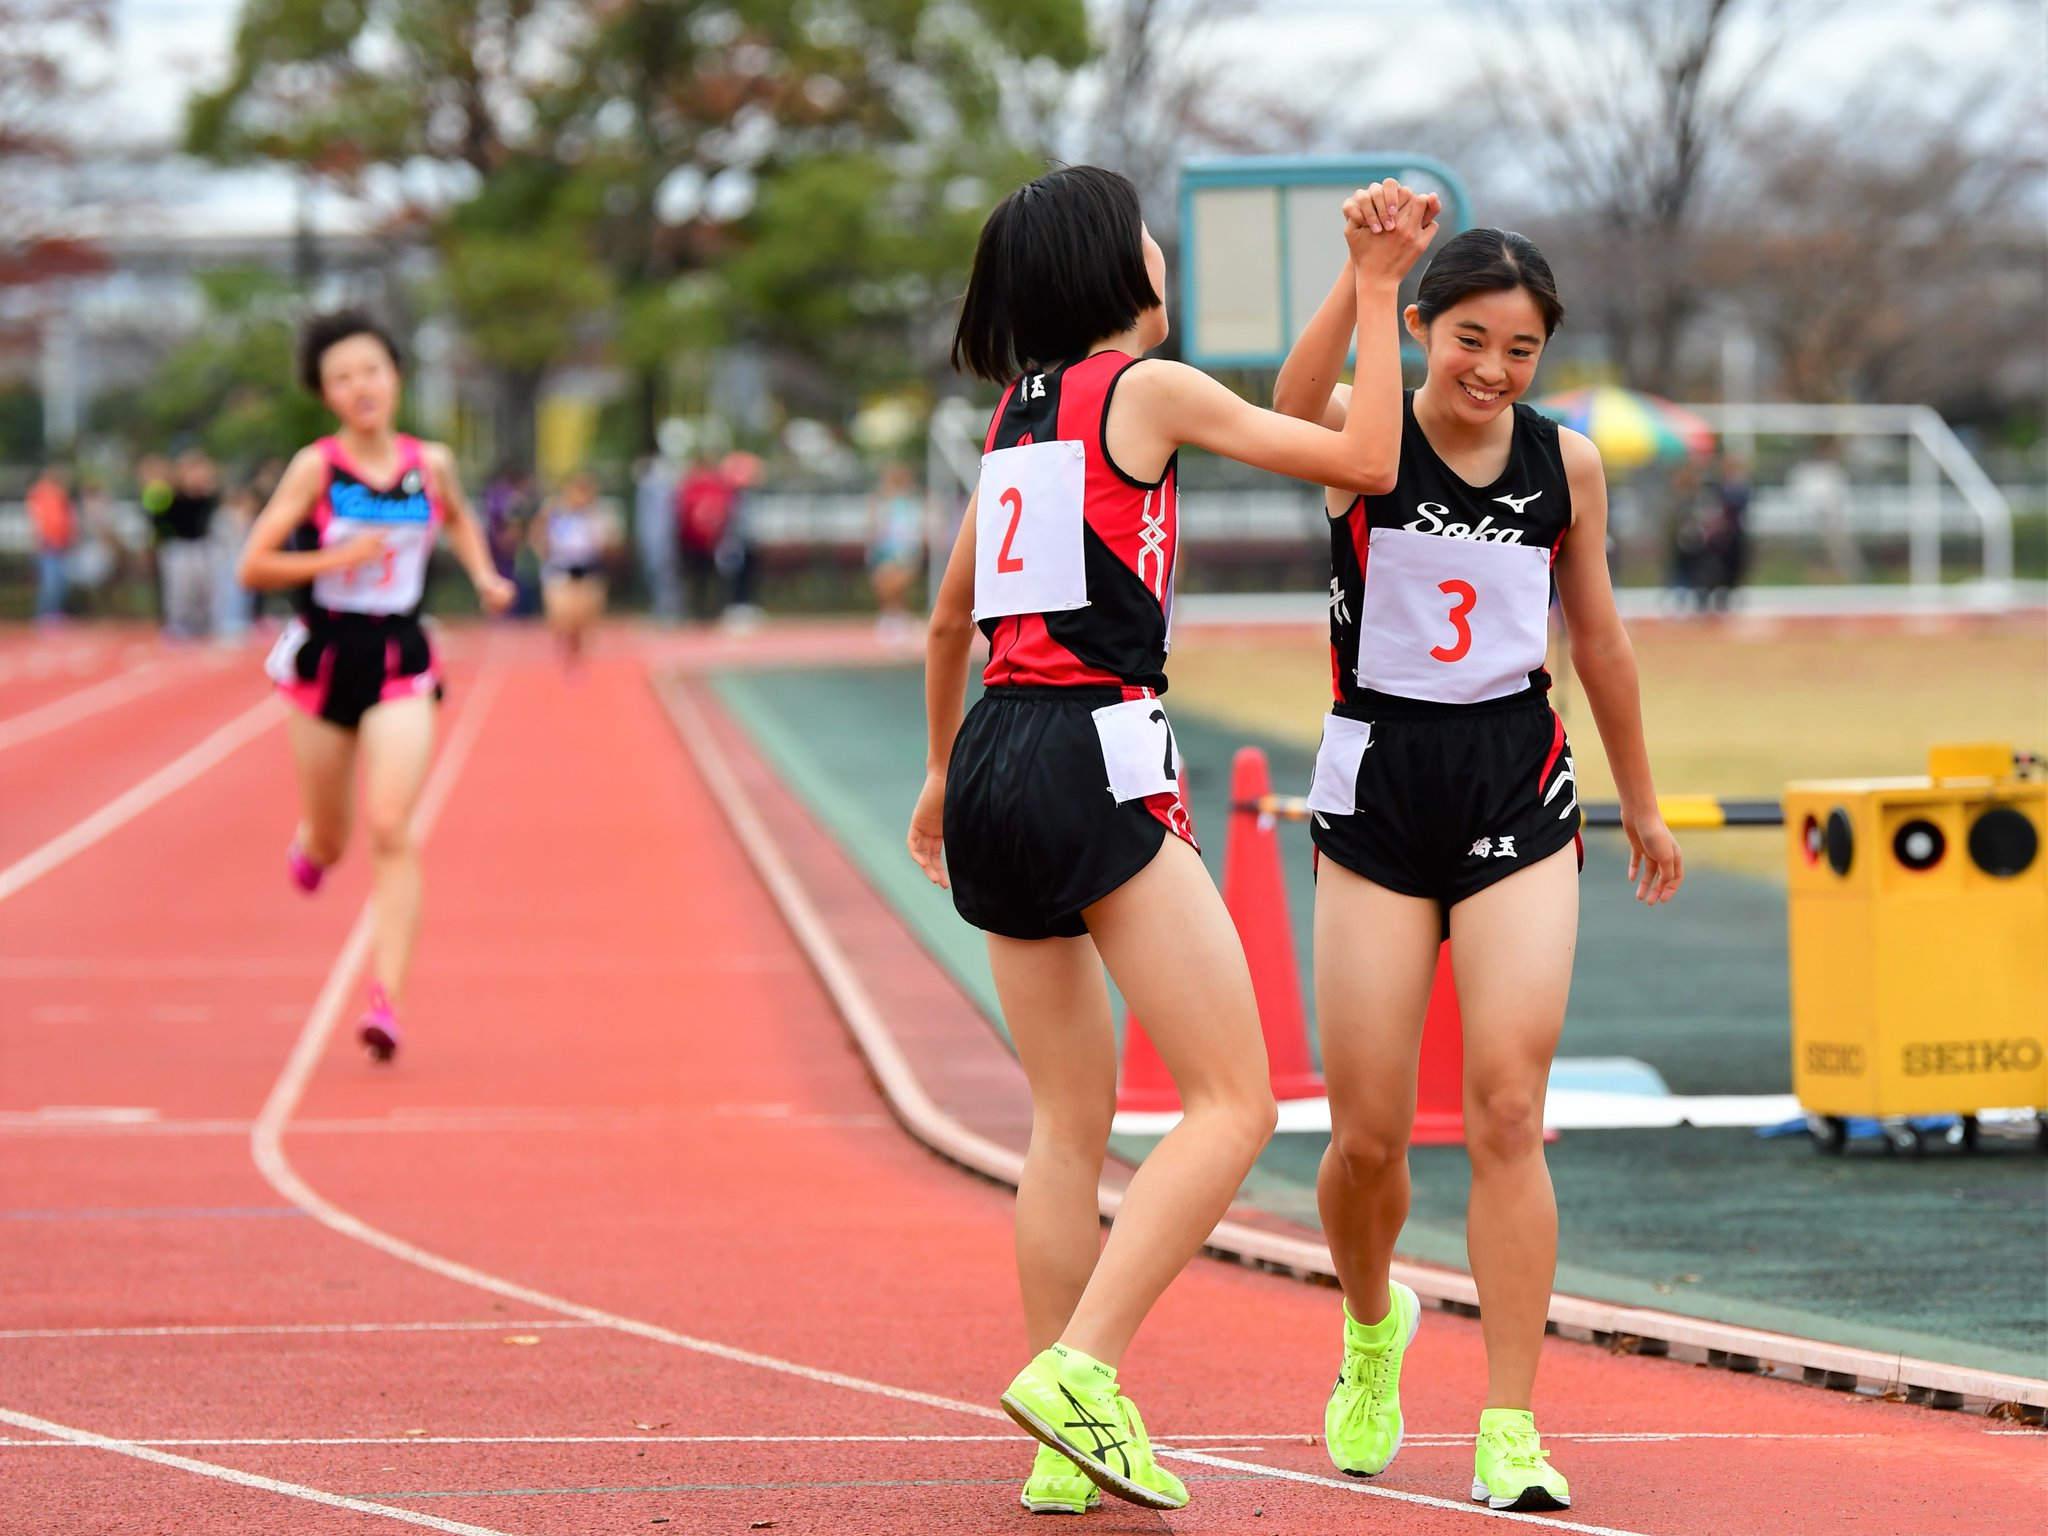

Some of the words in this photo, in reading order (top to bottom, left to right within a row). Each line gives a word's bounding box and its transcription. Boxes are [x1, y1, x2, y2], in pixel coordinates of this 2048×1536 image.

[997, 487, 1024, 574] 2
[1402, 502, 1525, 545] Soka
[1429, 579, 1477, 663] 3
[1149, 709, 1178, 781] 2
[1467, 836, 1518, 859] 埼玉
[1901, 1037, 2043, 1078] SEIKO
[1093, 1365, 1112, 1379] RXL
